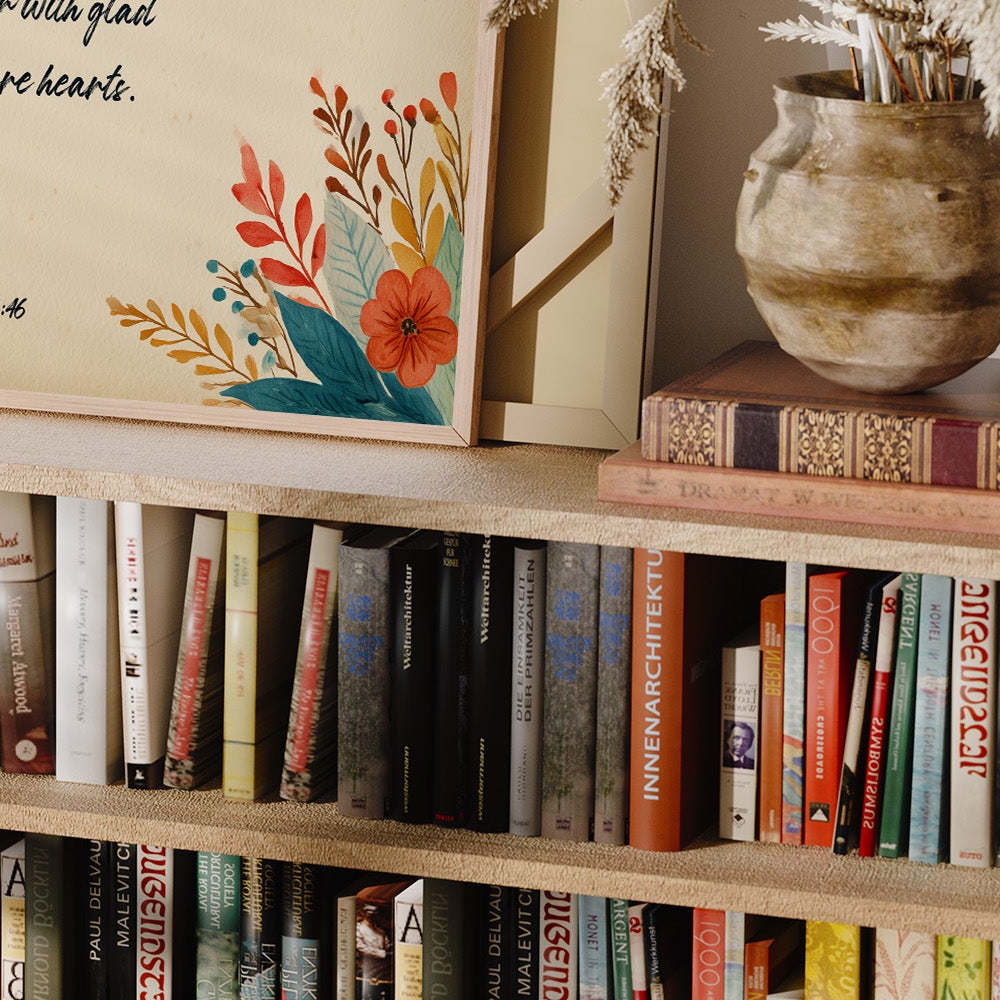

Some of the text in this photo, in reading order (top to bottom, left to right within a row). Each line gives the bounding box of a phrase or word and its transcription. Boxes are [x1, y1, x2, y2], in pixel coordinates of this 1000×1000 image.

[36, 64, 135, 102] hearts.
[402, 563, 413, 672] Weltarchitektur
[516, 574, 526, 723] DIE EINSAMKEIT
[523, 558, 535, 723] DER PRIMZAHLEN
[6, 595, 32, 715] Margaret Atwood
[403, 745, 411, 814] westermann
[476, 738, 486, 821] westermann
[89, 915, 102, 961] PAUL
[587, 914, 599, 952] MONET
[648, 925, 660, 975] Werkkunst
[694, 921, 722, 987] 1900
